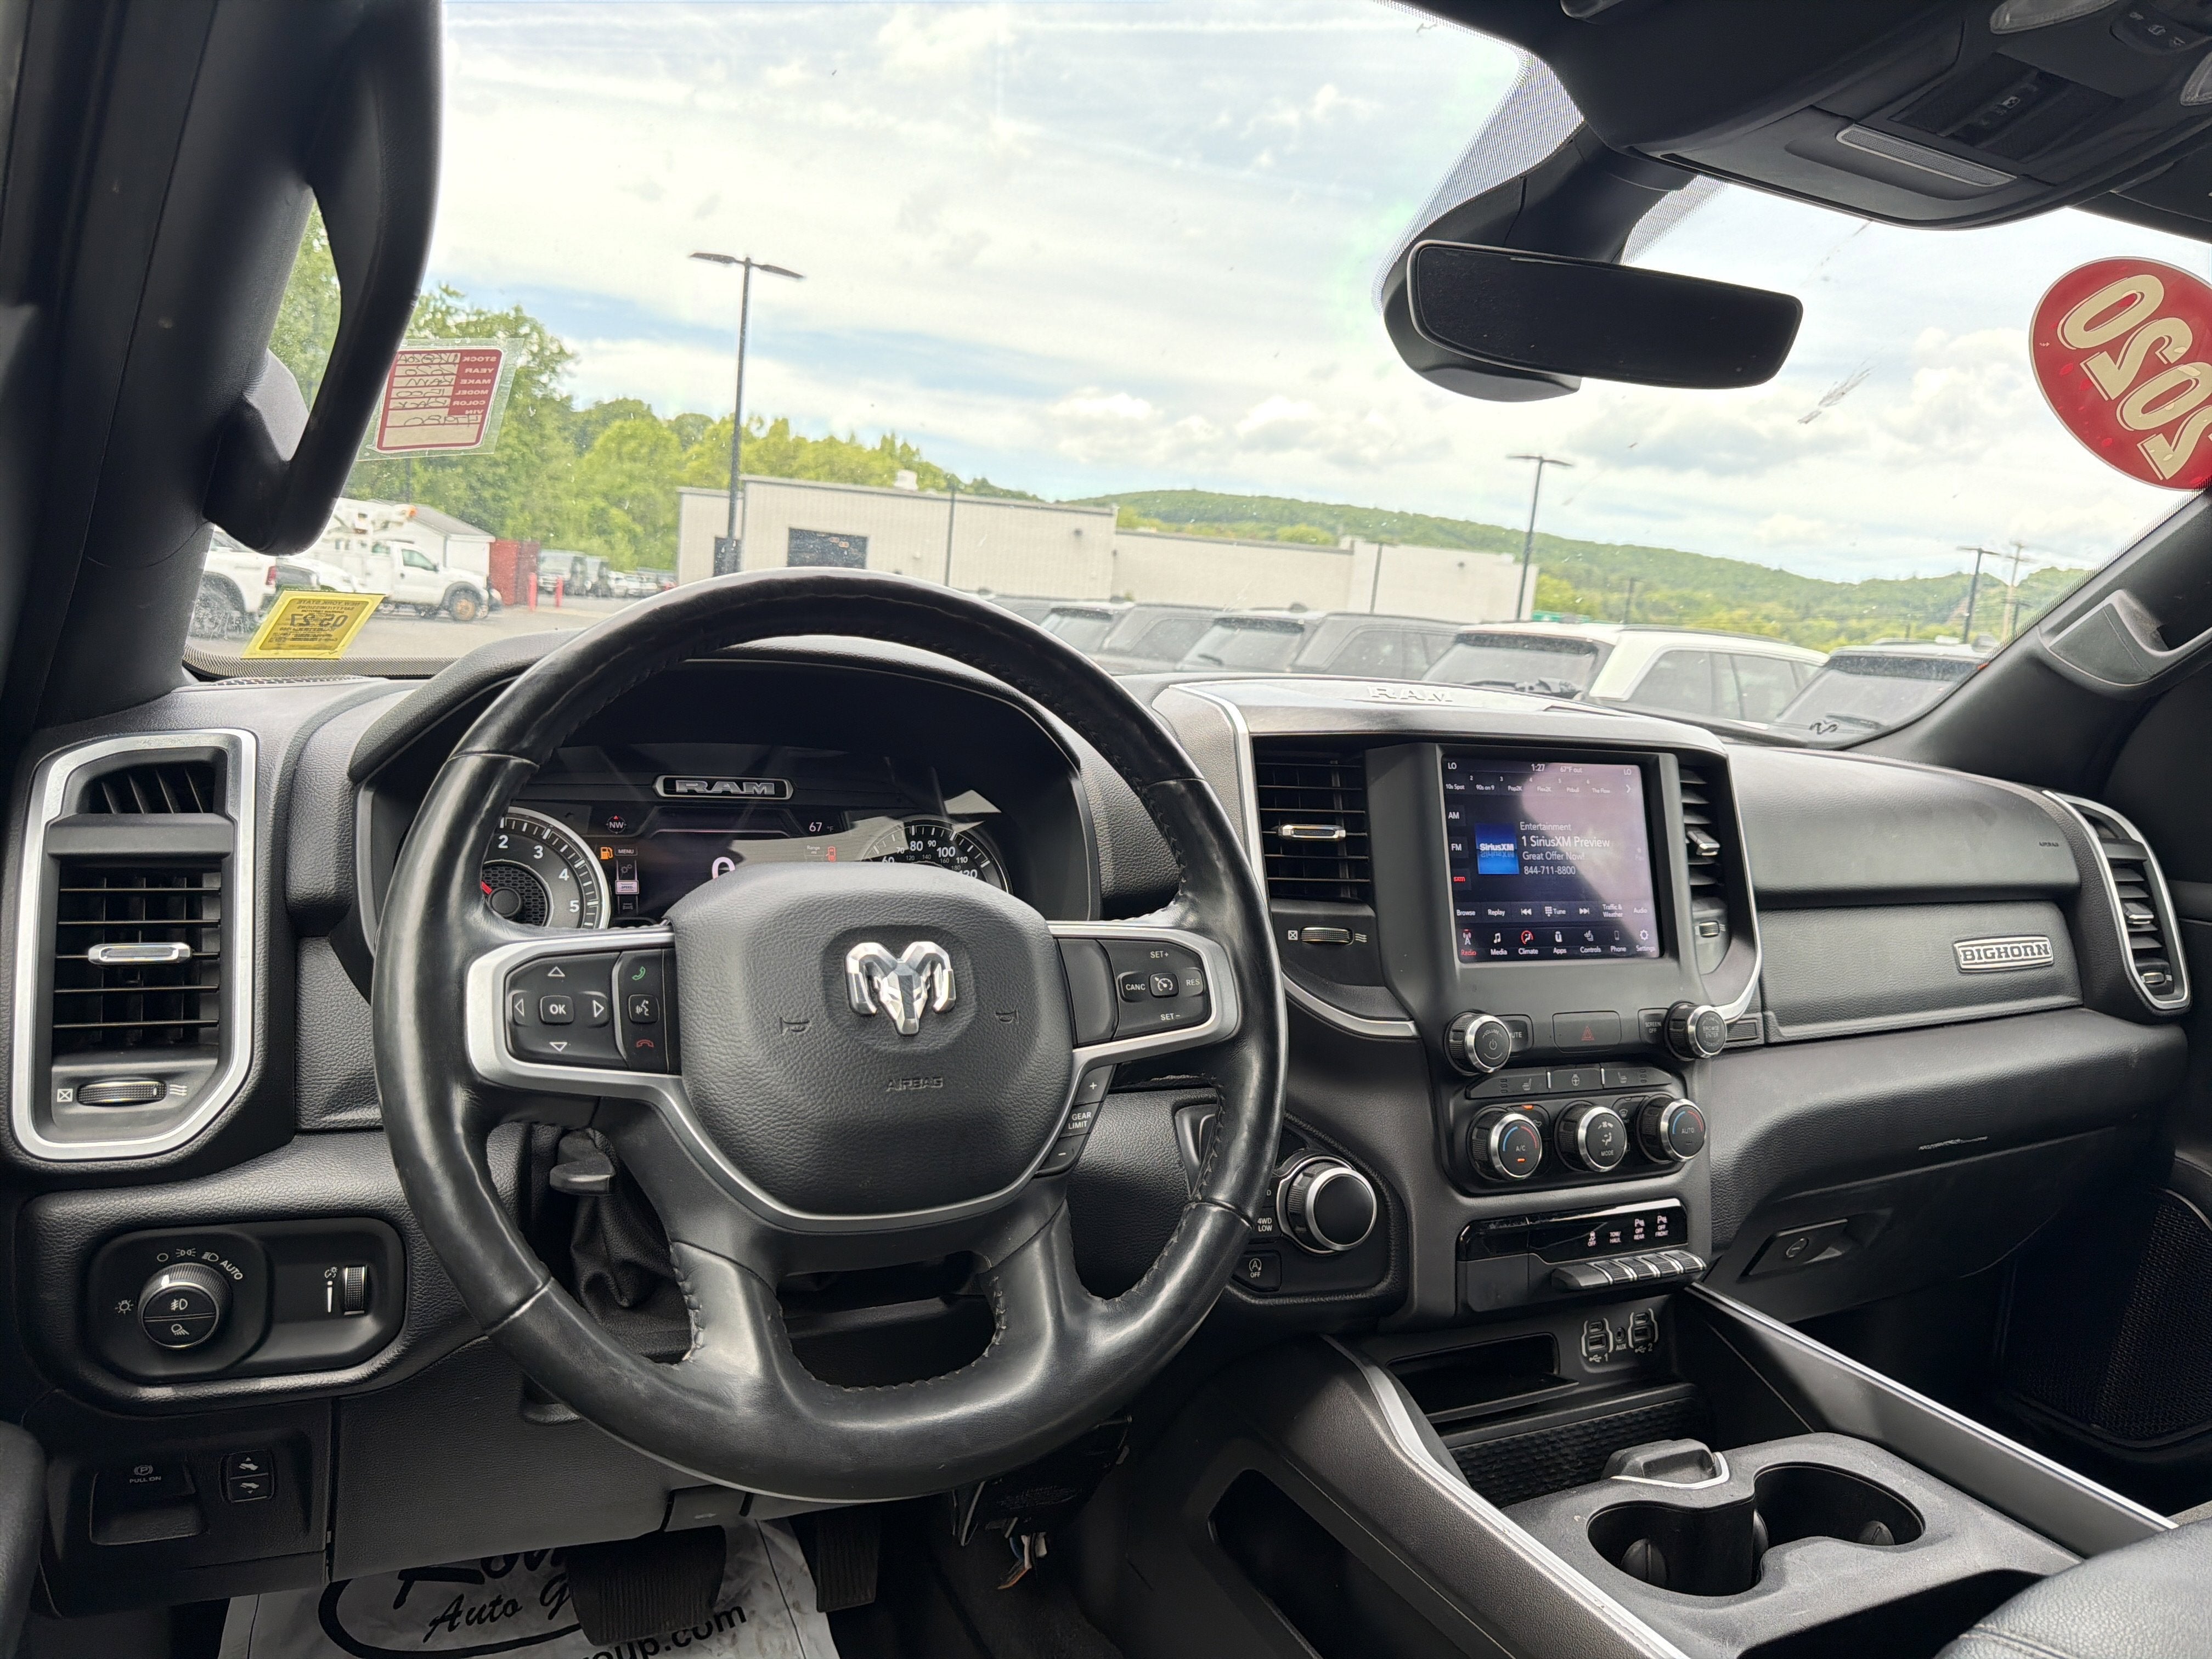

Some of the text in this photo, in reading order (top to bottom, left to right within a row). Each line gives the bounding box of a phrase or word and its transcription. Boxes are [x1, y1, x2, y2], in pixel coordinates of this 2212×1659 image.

[1368, 685, 1453, 702] RAM
[676, 779, 776, 795] RAM
[809, 822, 822, 832] 67
[1520, 822, 1571, 831] Entertainment
[498, 834, 509, 849] 2
[910, 840, 923, 851] 80
[1522, 836, 1610, 848] 1 SiriusXM Preview
[533, 845, 544, 859] 3
[936, 846, 956, 858] 100
[1480, 843, 1514, 852] SiriusXM
[1522, 851, 1585, 861] Great Offer Now!
[558, 868, 569, 881] 4
[1524, 866, 1576, 876] 844-711-8800
[569, 900, 579, 912] 5
[1488, 909, 1505, 917] Replay
[1636, 945, 1656, 953] Settings
[1960, 943, 2051, 962] BIGHORN
[550, 1004, 566, 1015] OK
[885, 1076, 944, 1091] AIRBAG
[1071, 1111, 1091, 1120] GEAR
[1068, 1120, 1088, 1130] LIMIT
[1258, 1224, 1273, 1233] LOW
[220, 1259, 243, 1280] AUTO
[421, 1594, 522, 1643] Auto
